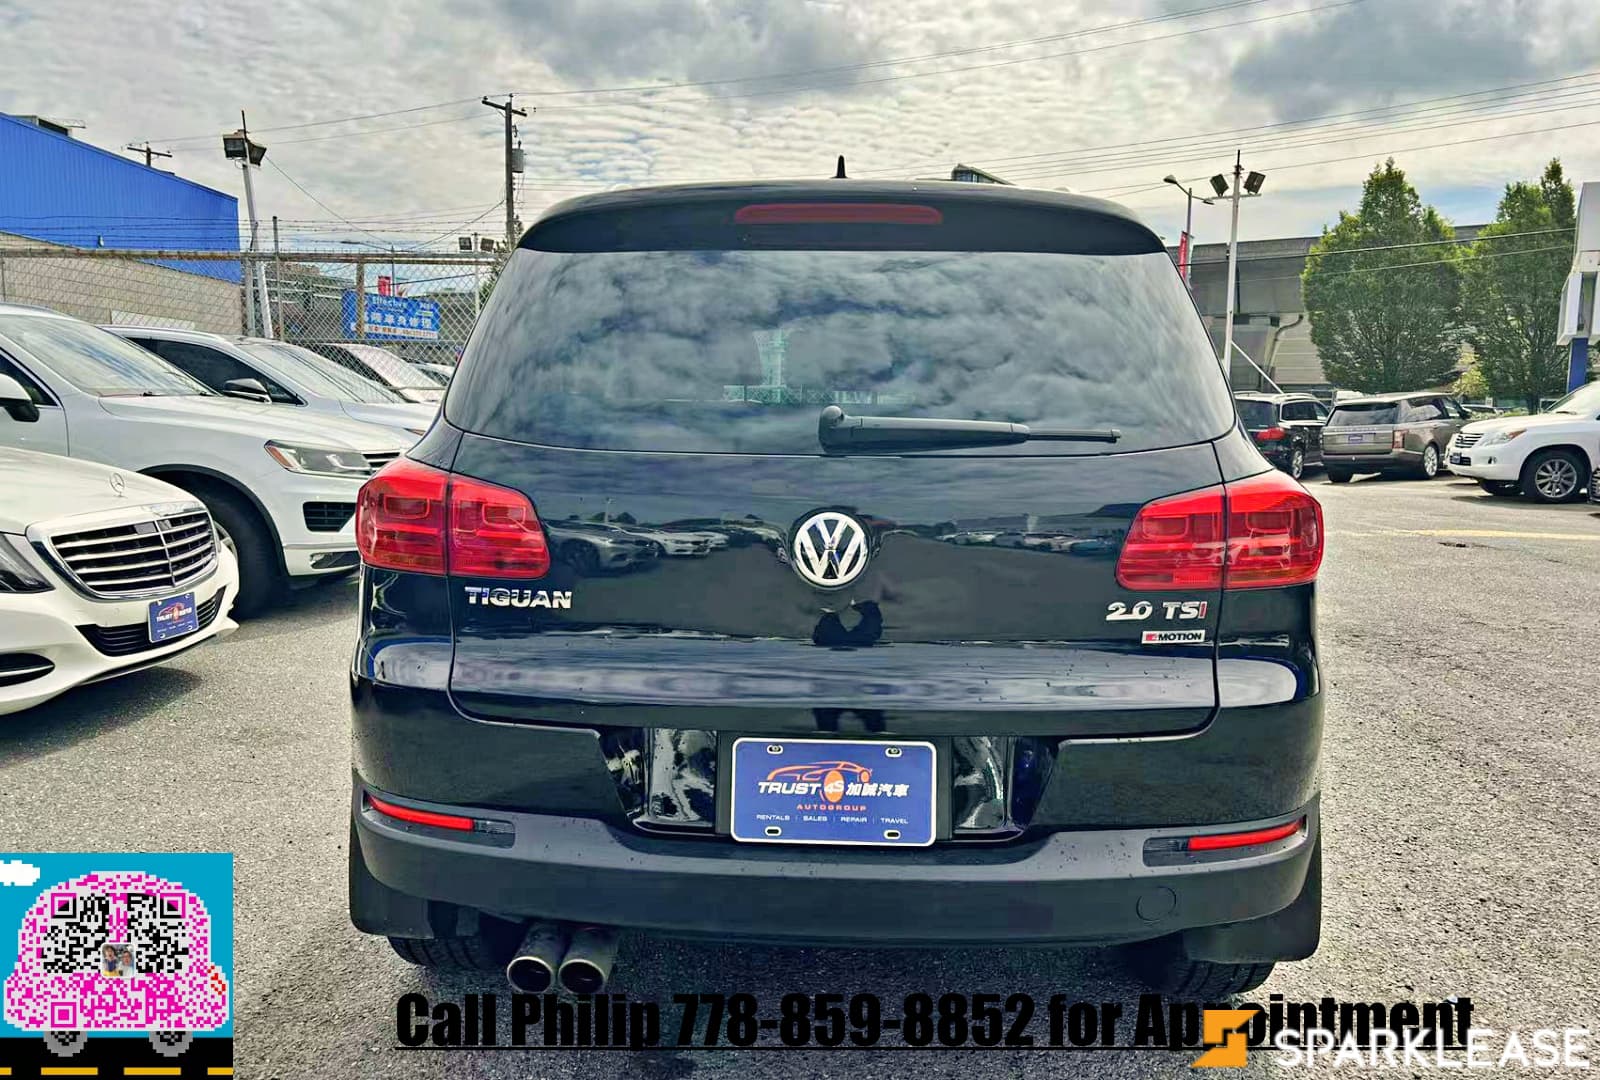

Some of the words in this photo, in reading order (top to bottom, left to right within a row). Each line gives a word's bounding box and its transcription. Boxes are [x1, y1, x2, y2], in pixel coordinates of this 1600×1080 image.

[464, 586, 573, 609] TIGUAN
[1162, 601, 1208, 620] TSI
[758, 781, 821, 795] TRUST
[796, 803, 867, 812] AUTOGROUP
